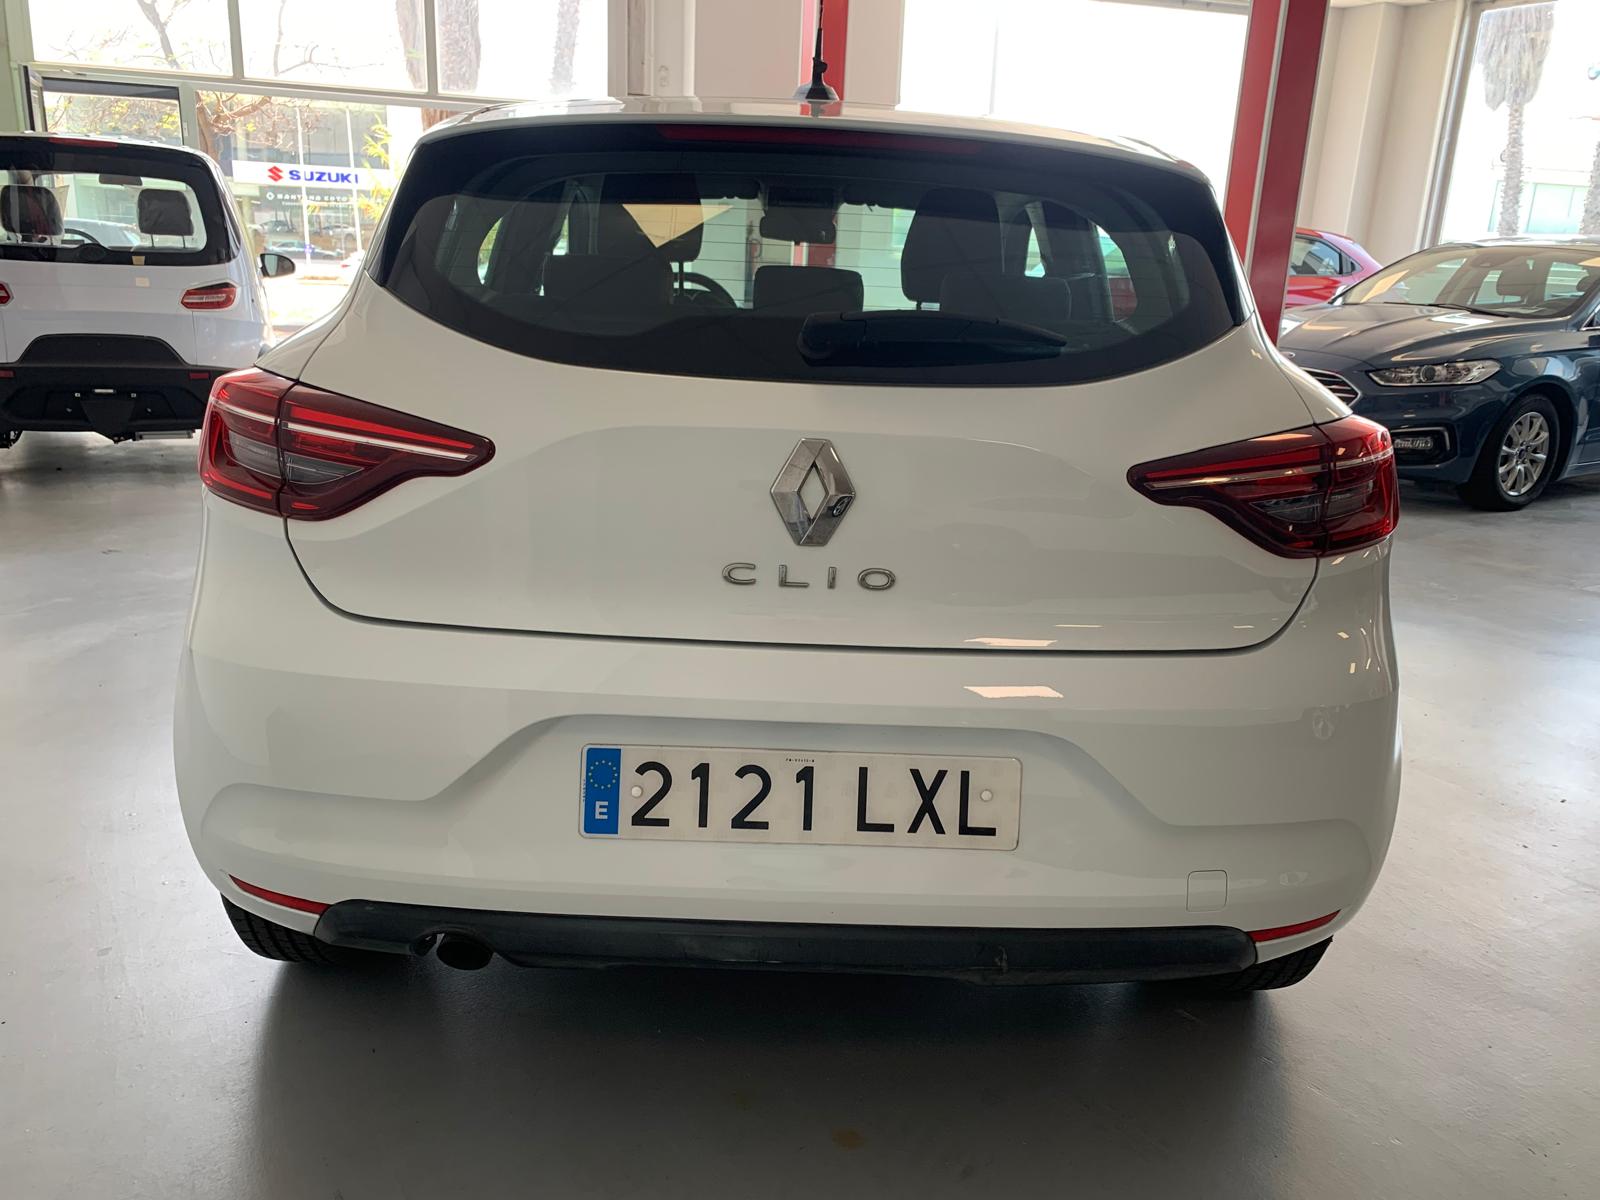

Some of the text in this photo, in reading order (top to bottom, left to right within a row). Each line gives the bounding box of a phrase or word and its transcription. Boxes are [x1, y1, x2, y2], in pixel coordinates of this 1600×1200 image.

[289, 169, 359, 184] SUZUKI
[722, 562, 896, 591] CLIO
[595, 801, 609, 820] E
[631, 761, 997, 837] 2121 LXL
